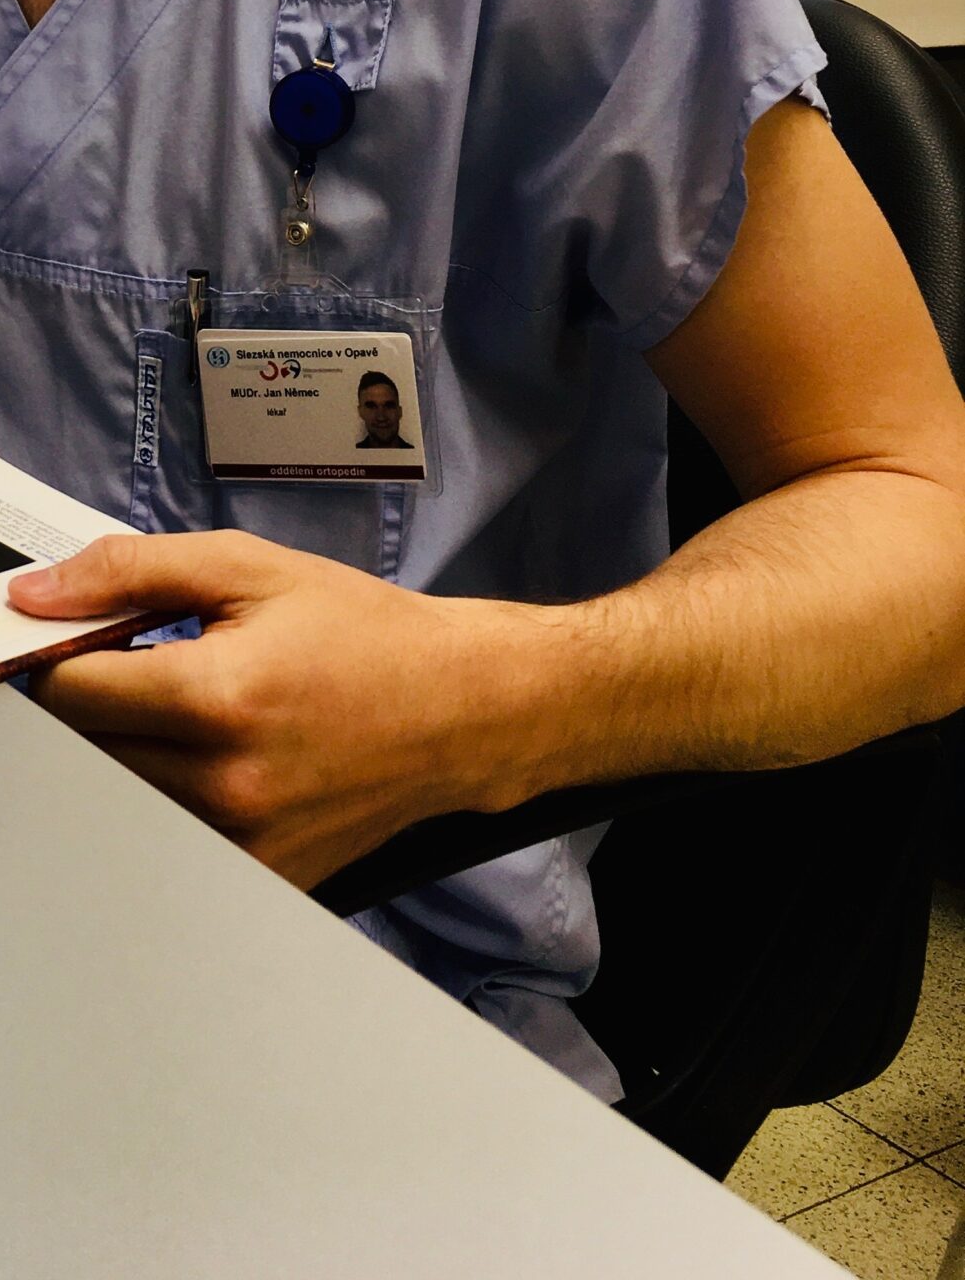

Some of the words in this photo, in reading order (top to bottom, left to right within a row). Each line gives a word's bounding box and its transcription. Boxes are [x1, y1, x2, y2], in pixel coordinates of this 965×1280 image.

[236, 348, 275, 360] Slezská
[277, 349, 333, 359] nemocnice
[345, 347, 378, 359] Opavě
[230, 388, 261, 398] MUDr.
[263, 388, 282, 398] Jan
[284, 387, 320, 398] Němec
[266, 407, 287, 417] lékař
[270, 466, 314, 476] oddělení
[316, 466, 366, 478] ortopedie
